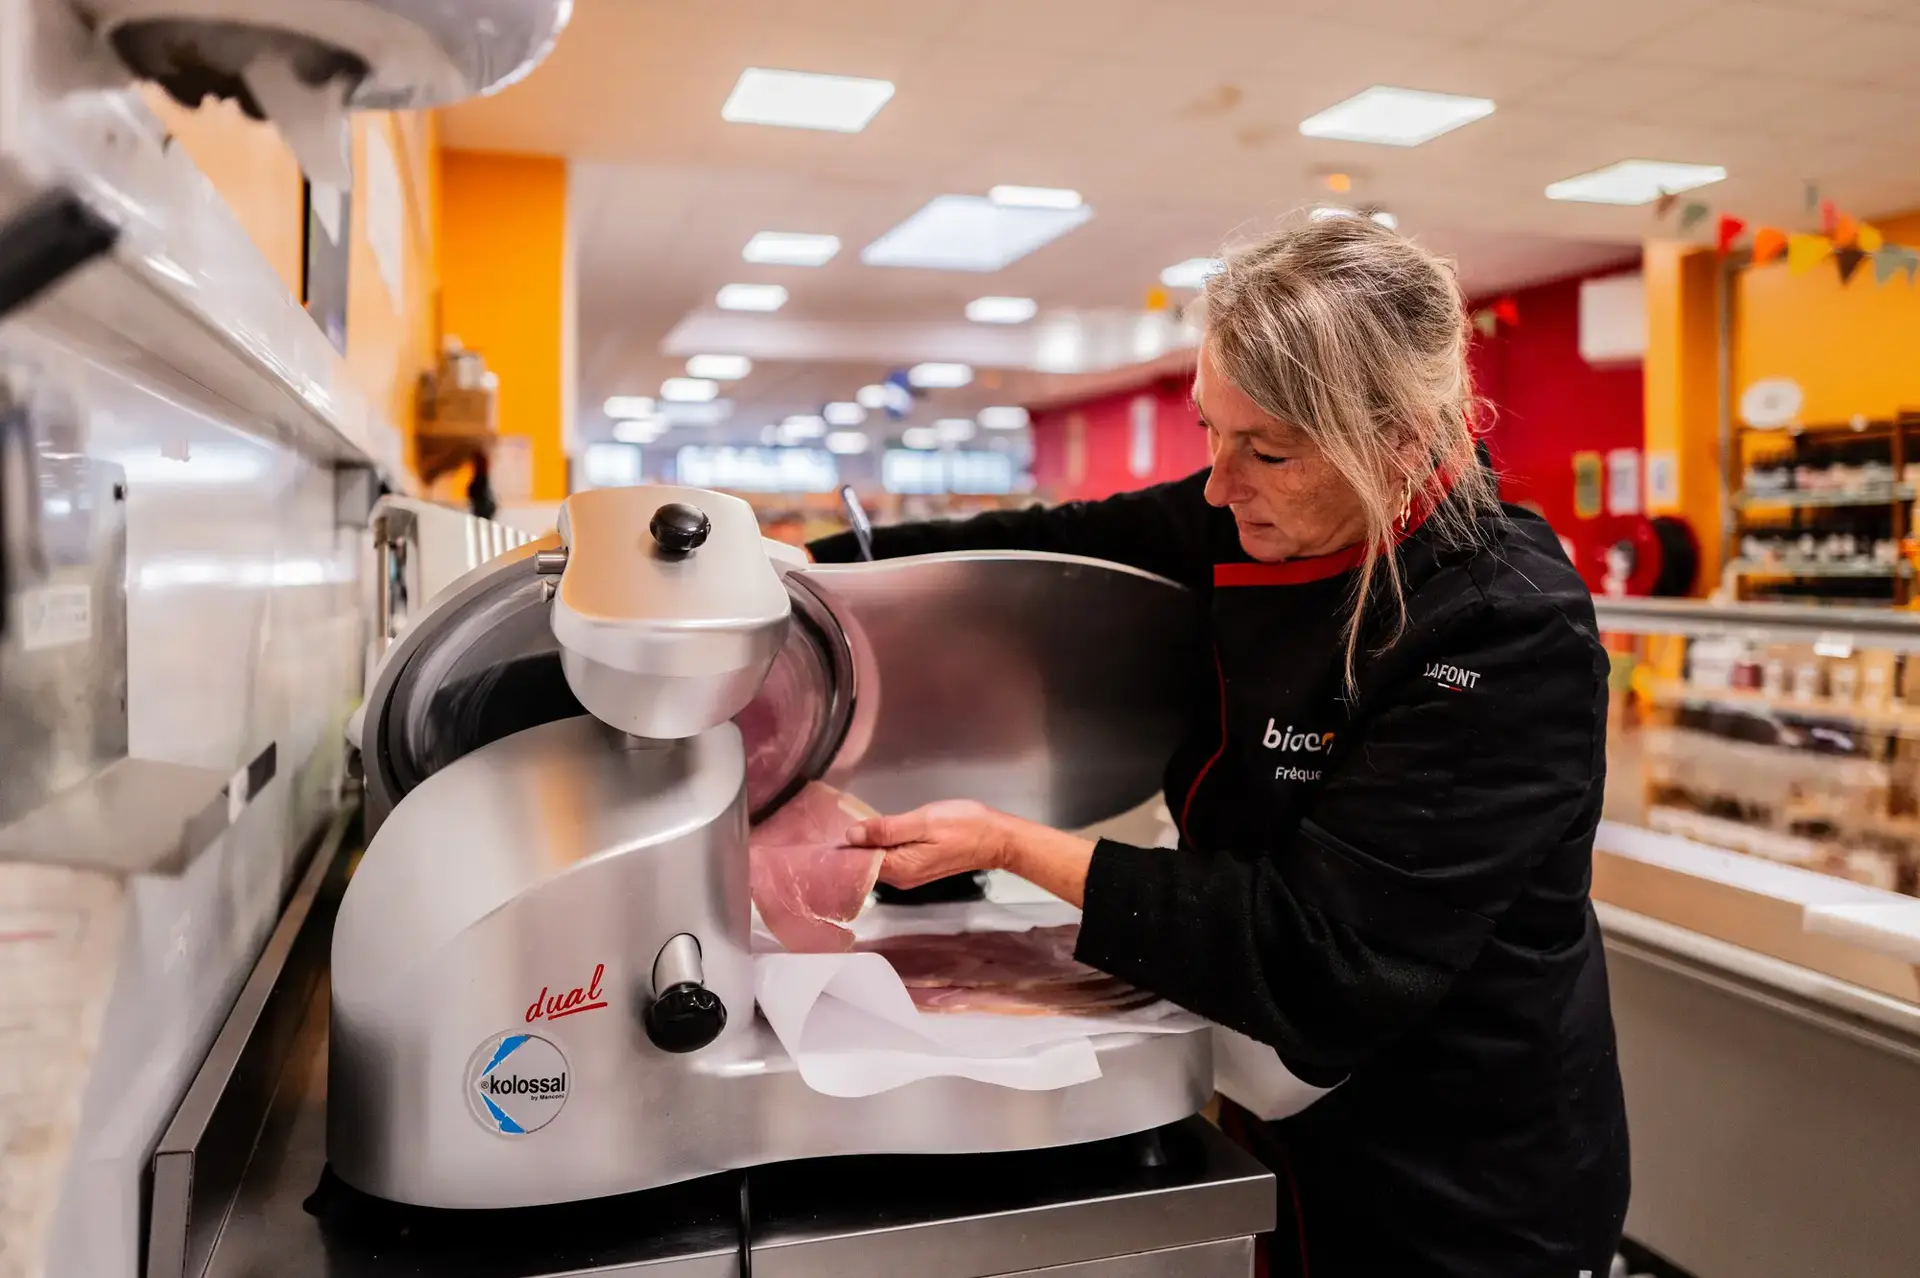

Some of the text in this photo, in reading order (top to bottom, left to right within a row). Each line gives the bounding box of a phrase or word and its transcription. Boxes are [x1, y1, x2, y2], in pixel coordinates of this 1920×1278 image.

[1423, 662, 1481, 689] LAFONT
[525, 963, 605, 1023] dual
[490, 1072, 566, 1095] kolossal
